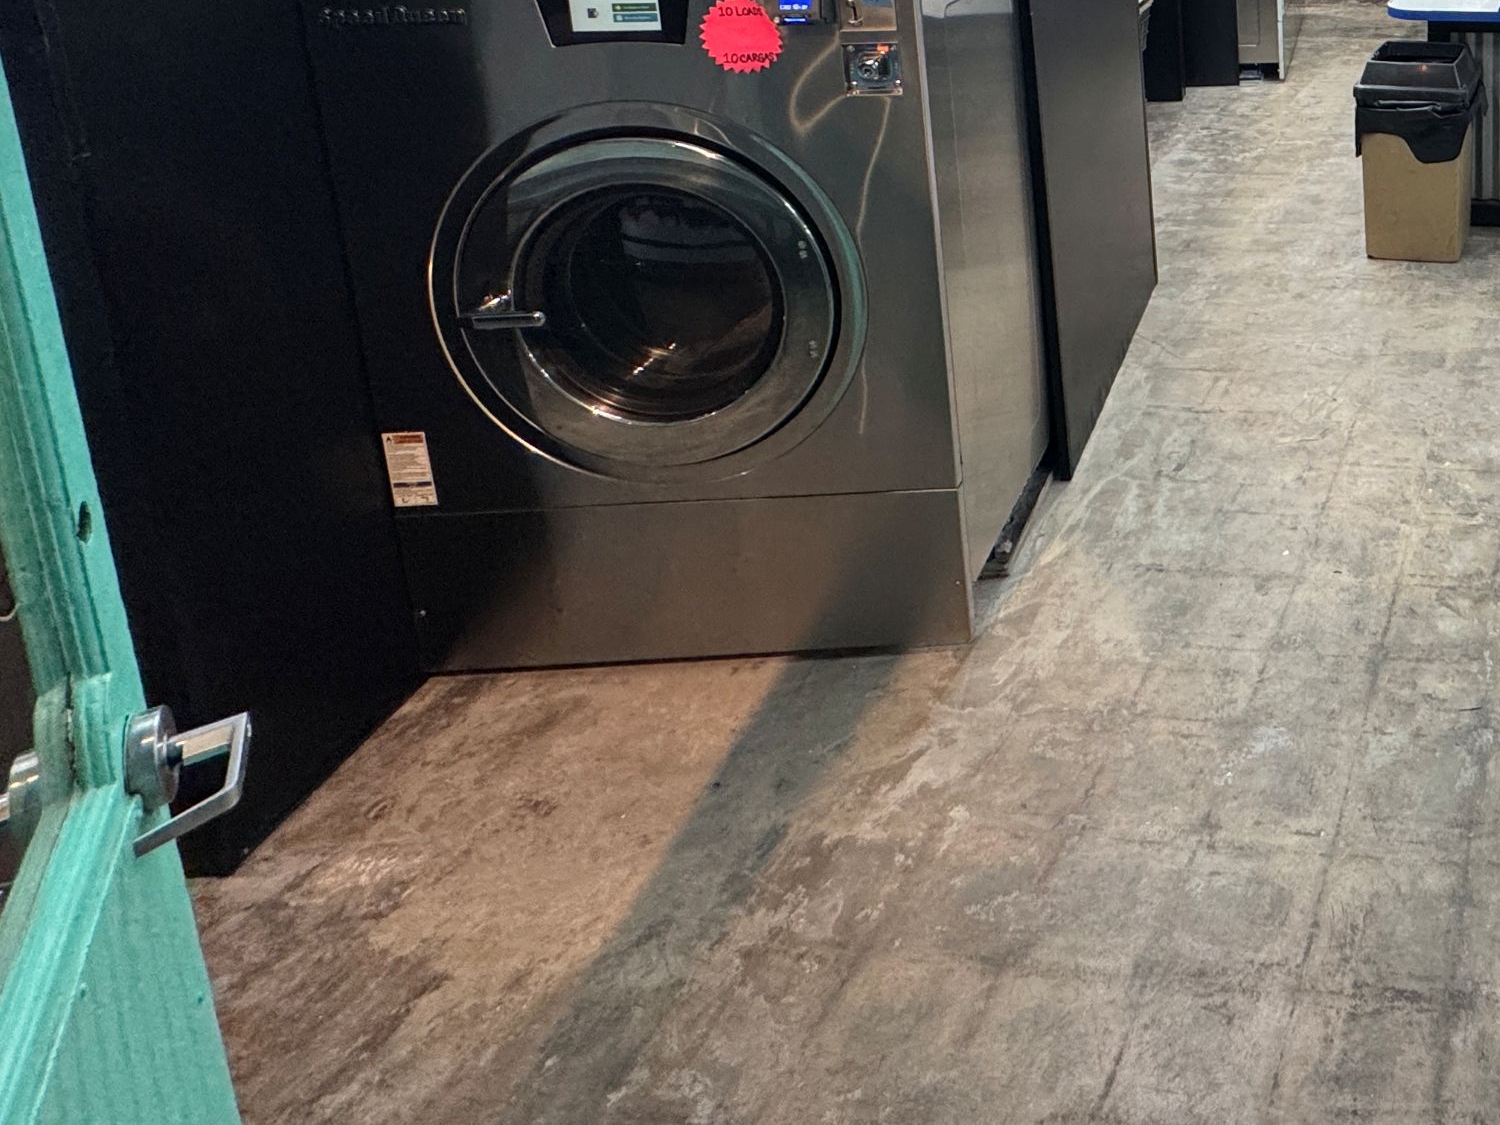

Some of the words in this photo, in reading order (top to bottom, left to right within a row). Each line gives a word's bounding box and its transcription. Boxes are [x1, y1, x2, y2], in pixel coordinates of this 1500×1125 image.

[718, 6, 733, 17] 10
[735, 6, 763, 17] LOADS
[723, 52, 738, 64] 10
[740, 51, 774, 64] CARGAS
